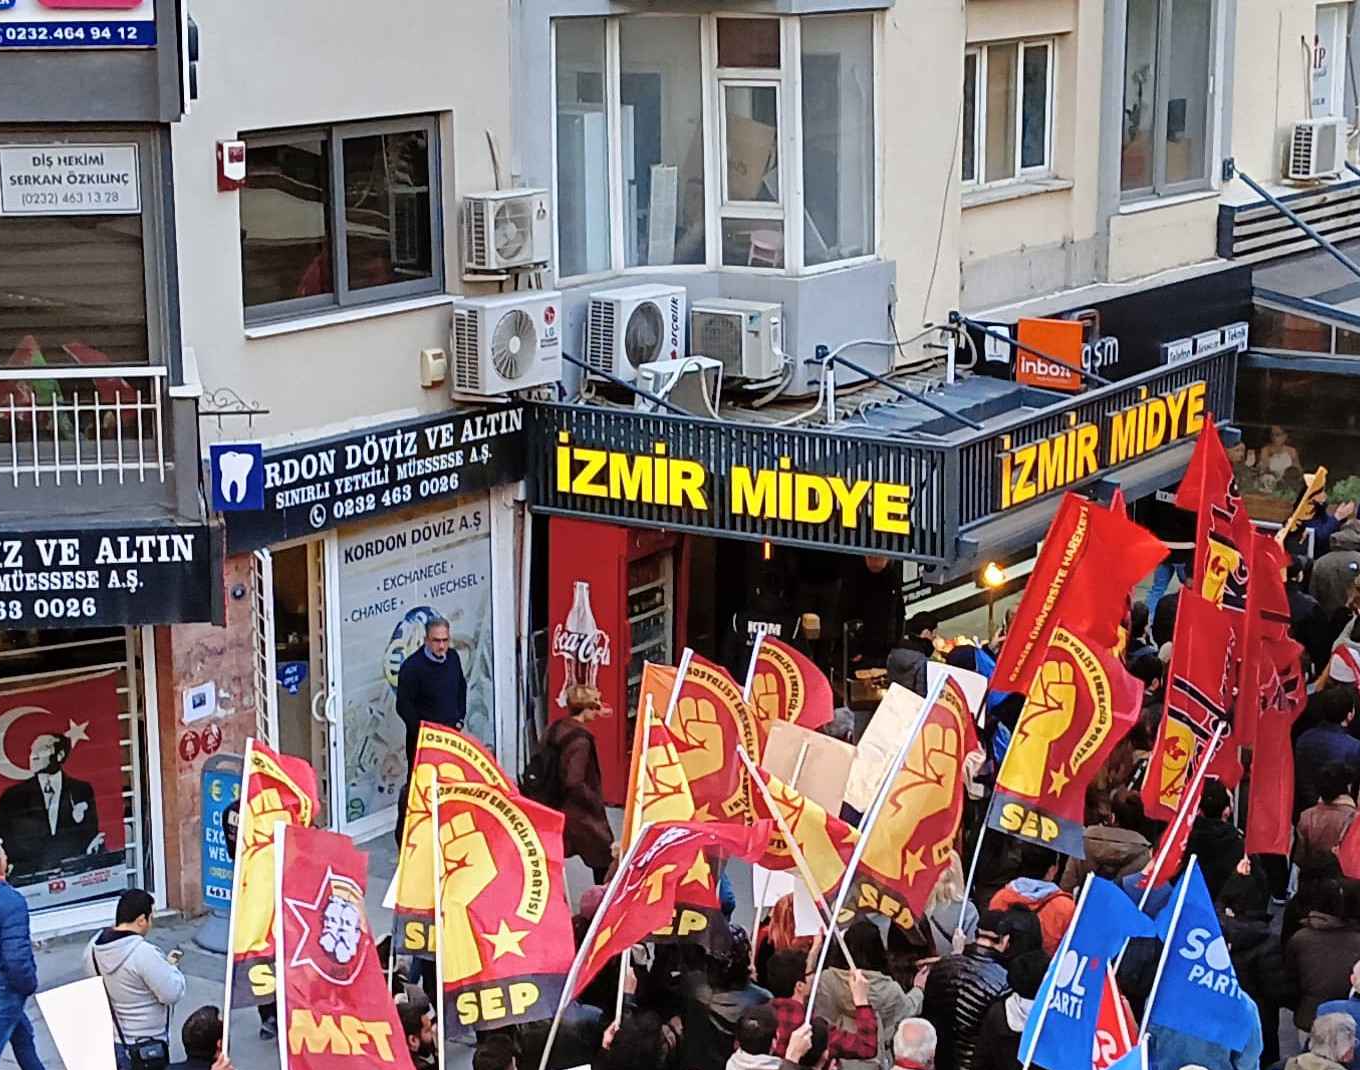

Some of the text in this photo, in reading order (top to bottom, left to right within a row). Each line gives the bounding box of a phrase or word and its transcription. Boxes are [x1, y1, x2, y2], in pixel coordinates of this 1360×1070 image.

[6, 26, 137, 41] 0232.464 94 12
[32, 153, 104, 168] DİŞ HEKİMİ
[9, 174, 62, 186] SERKAN
[22, 192, 58, 206] (0232)
[671, 296, 680, 346] arçelik
[264, 407, 524, 489] RDON DÖVİZ VE ALTIN
[998, 380, 1207, 511] İZMİR MİDYE
[275, 482, 330, 510] SINIRLI
[335, 467, 390, 496] YETKİLİ
[396, 451, 464, 484] MÜESSESE
[333, 474, 459, 520] 0232 463 0026
[557, 431, 912, 535] İZMİR MİDYE
[36, 538, 81, 567] VE
[96, 533, 195, 565] ALTIN
[344, 532, 407, 564] KORDON
[411, 516, 455, 545] DÖVİZ
[108, 570, 144, 595] A.Ş.
[430, 573, 478, 599] WECHSEL
[32, 596, 97, 620] 0026
[351, 597, 397, 623] CHANGE
[999, 802, 1059, 845] SEP
[456, 982, 540, 1026] SEP
